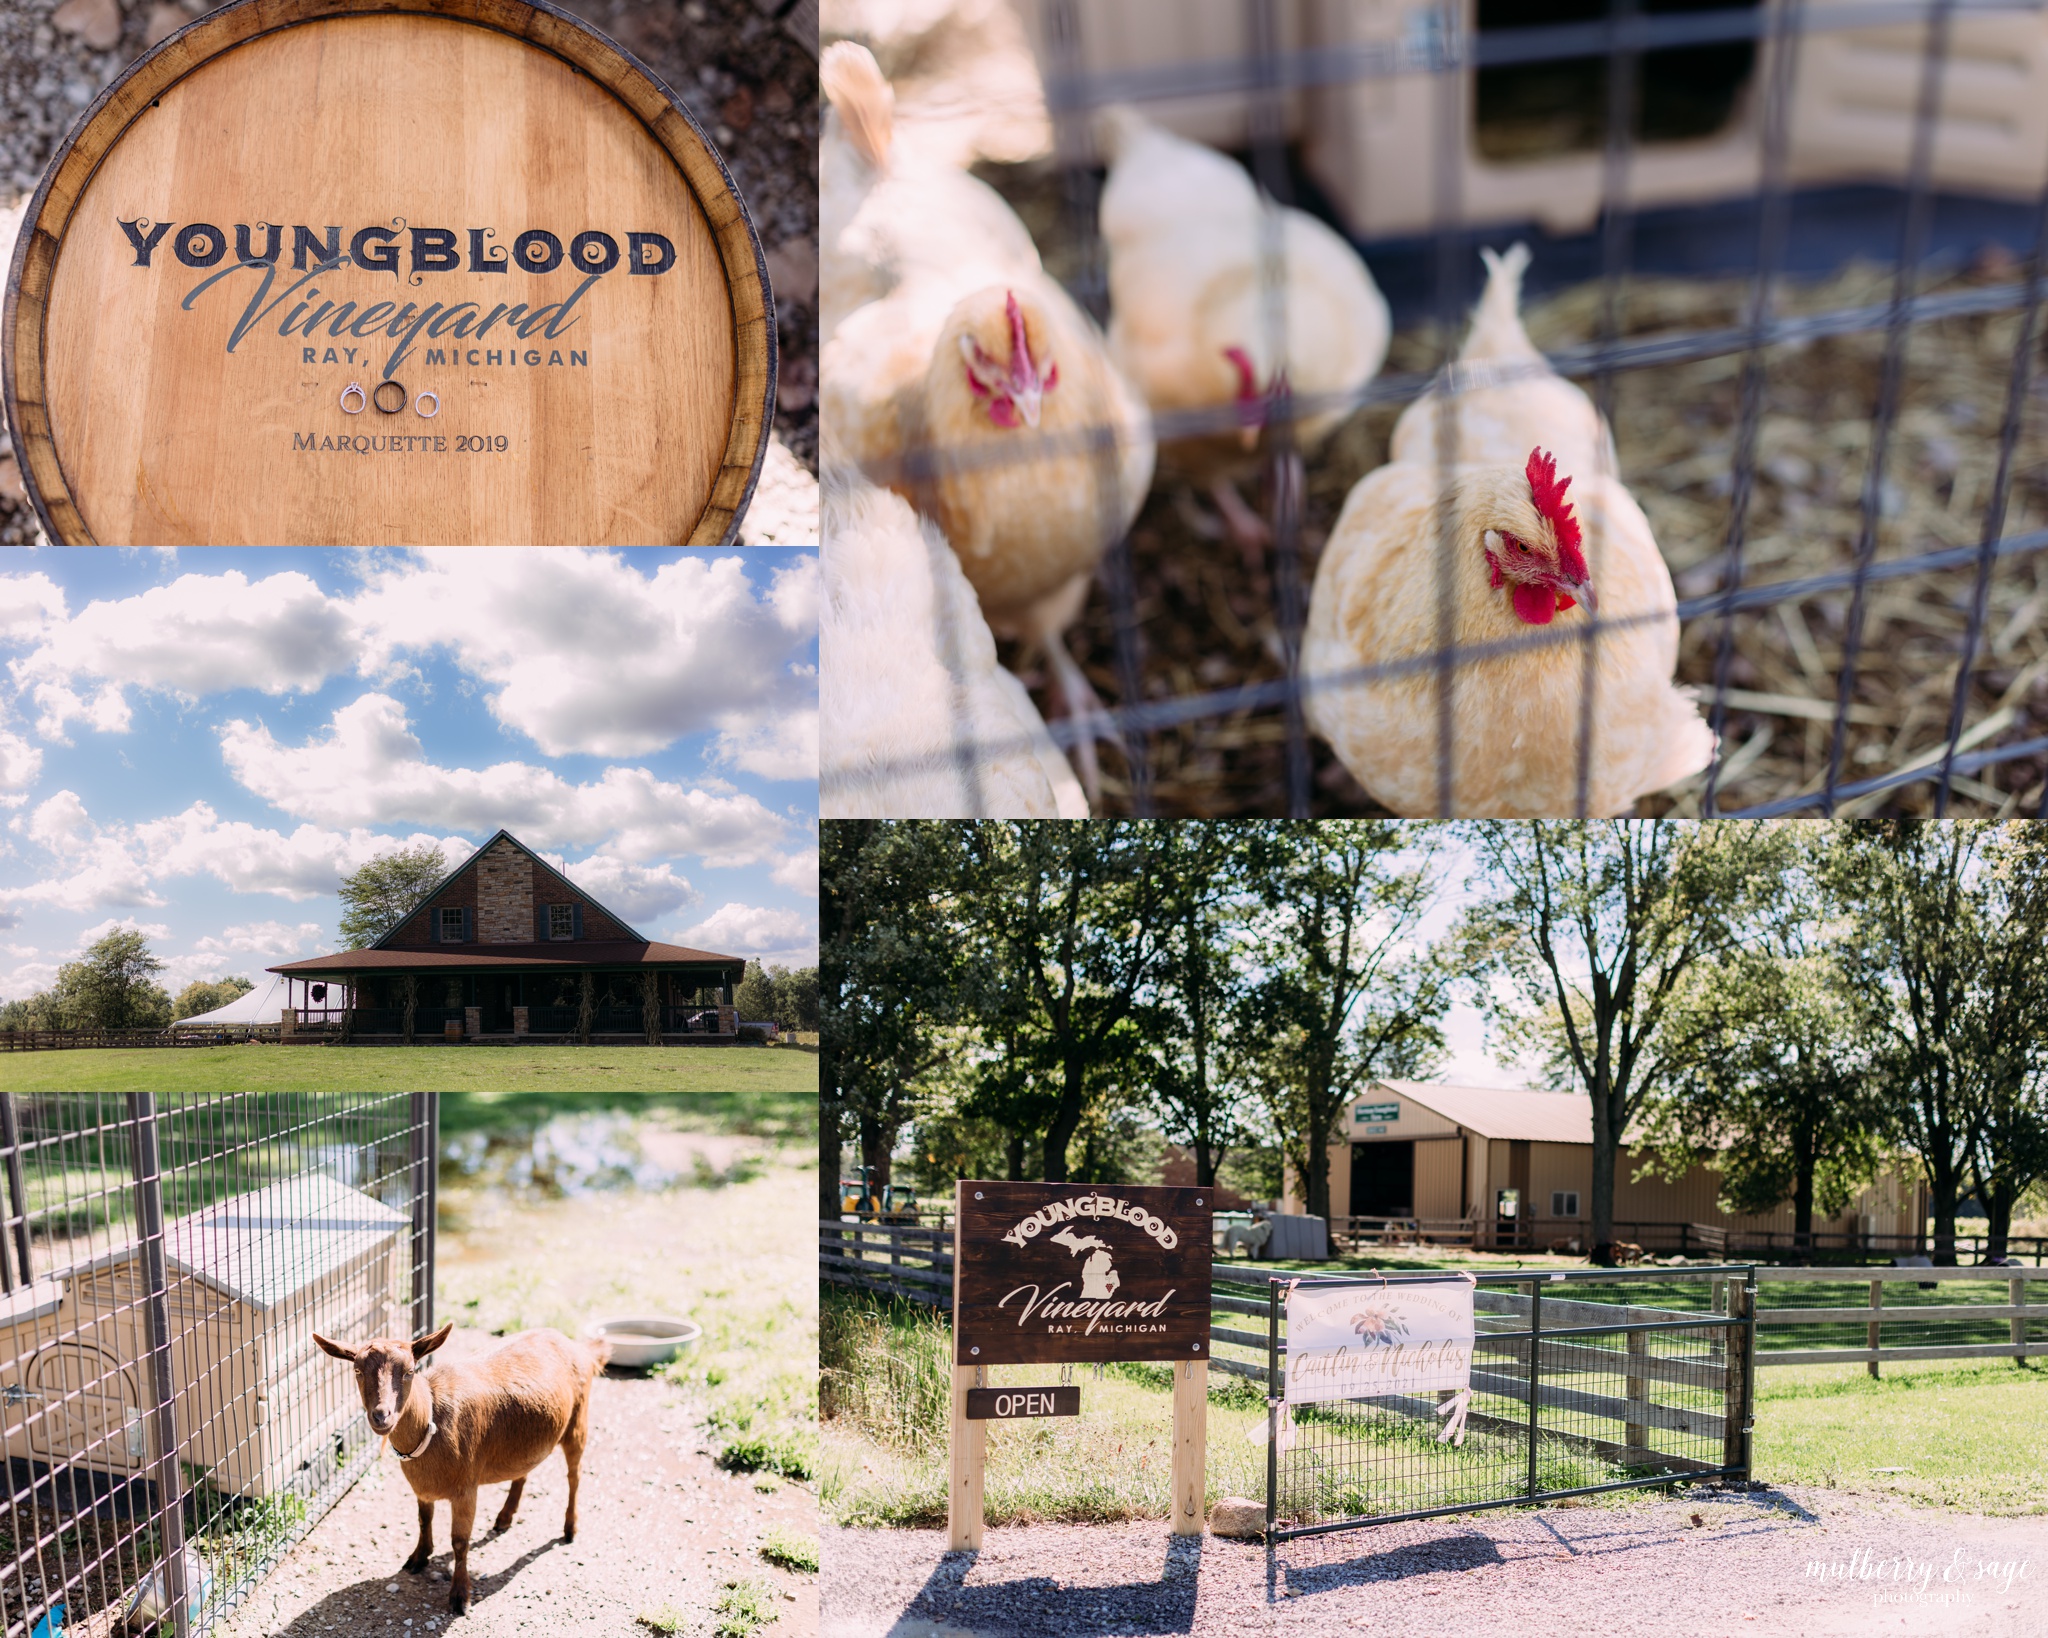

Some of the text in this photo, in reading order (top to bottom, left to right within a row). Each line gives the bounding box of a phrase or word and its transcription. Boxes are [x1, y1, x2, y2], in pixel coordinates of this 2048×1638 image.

[116, 216, 677, 287] YOUNGBLOOD
[182, 256, 601, 380] Vineyard
[302, 347, 589, 368] RAY, MICHIGAN
[292, 432, 509, 455] MARQUETTE 2019
[1001, 1191, 1179, 1250] YOUNGBLOOD
[998, 1281, 1177, 1337] Vineyard
[1099, 1323, 1167, 1333] MICHIGAN
[1295, 1291, 1463, 1333] WELCOME TO THE WEDDING OF
[1291, 1338, 1467, 1383] Caitlin & Nicholas
[995, 1393, 1055, 1416] OPEN
[1340, 1377, 1416, 1395] 09.25.2021
